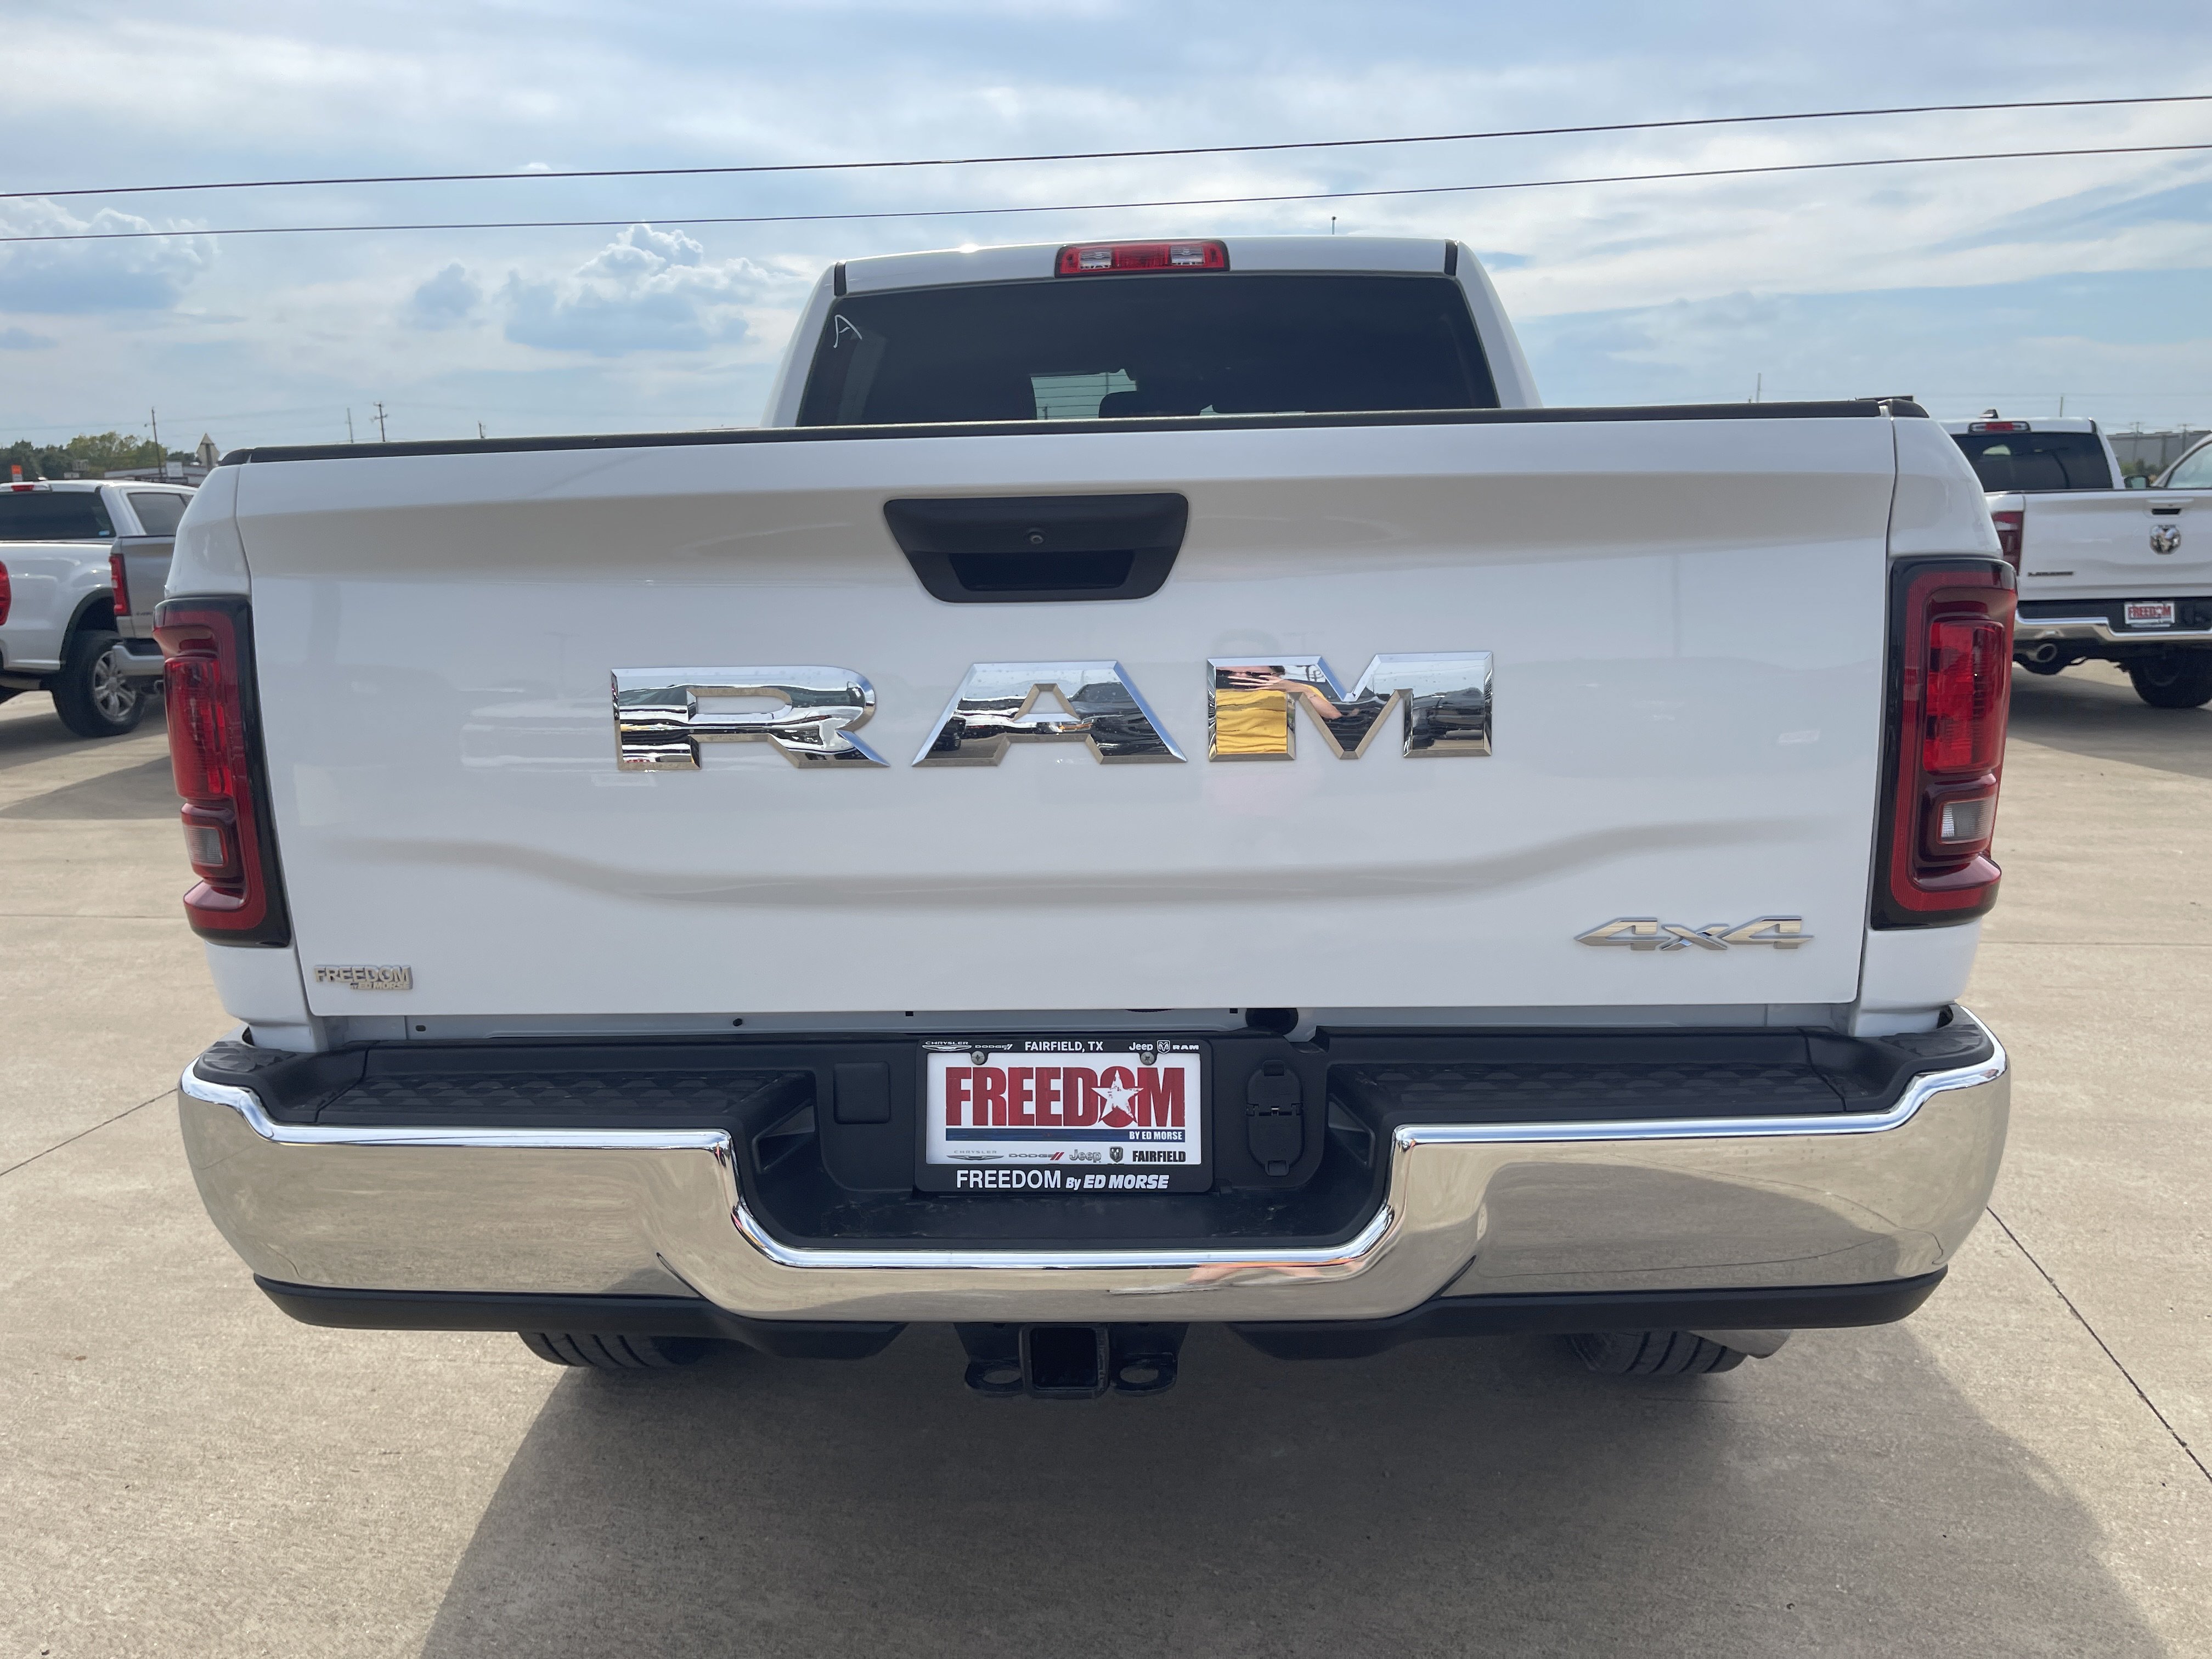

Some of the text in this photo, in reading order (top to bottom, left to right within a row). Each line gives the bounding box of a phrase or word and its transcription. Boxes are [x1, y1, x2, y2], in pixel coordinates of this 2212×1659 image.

[610, 651, 1493, 770] RAM
[1574, 916, 1814, 951] 4x4
[314, 965, 412, 983] FREEDOM
[1025, 1041, 1103, 1053] FAIRFIELD, TX
[1128, 1042, 1153, 1051] Jeep
[945, 1066, 1186, 1127] FREEDOM
[1129, 1131, 1182, 1140] BY ED MORSE
[1069, 1149, 1102, 1163] Jeep
[1132, 1150, 1186, 1162] FAIRFIELD
[956, 1170, 1170, 1190] FREEDOM By ED MORSE
